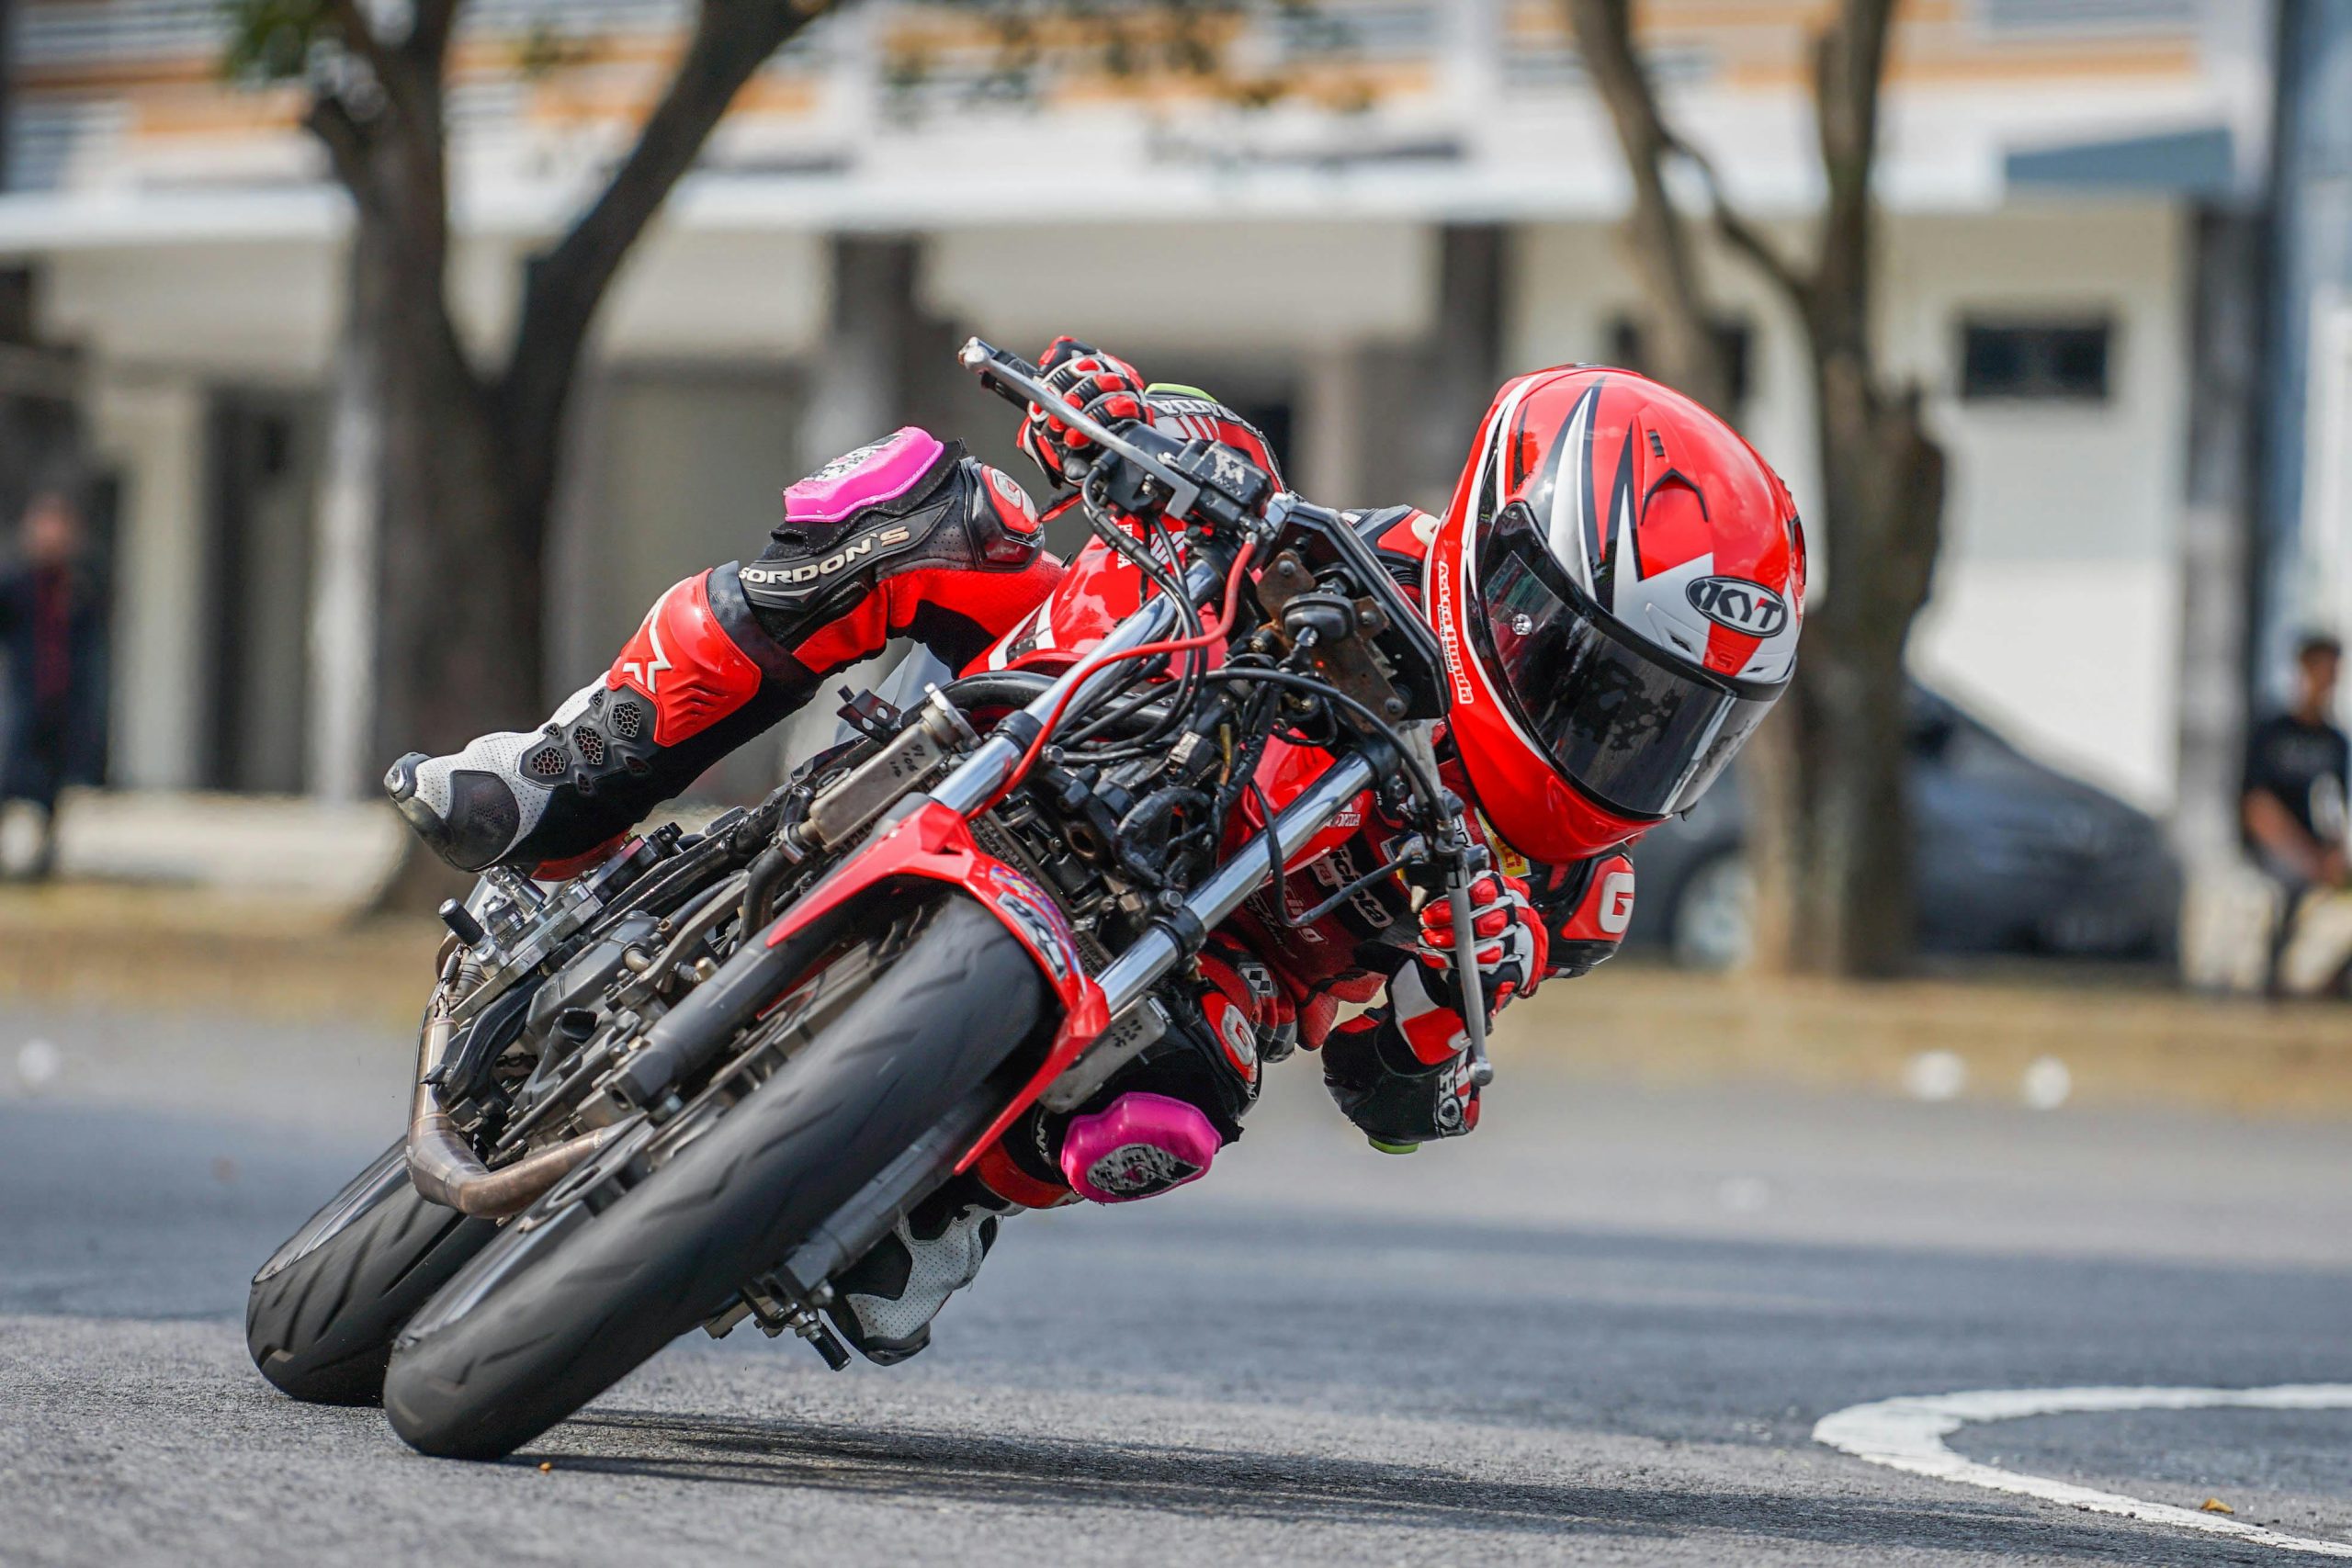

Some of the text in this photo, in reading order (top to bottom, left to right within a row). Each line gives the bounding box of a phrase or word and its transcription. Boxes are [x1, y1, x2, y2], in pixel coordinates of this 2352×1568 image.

[1439, 560, 1474, 704] Astra Honda
[1697, 580, 1783, 629] KYT
